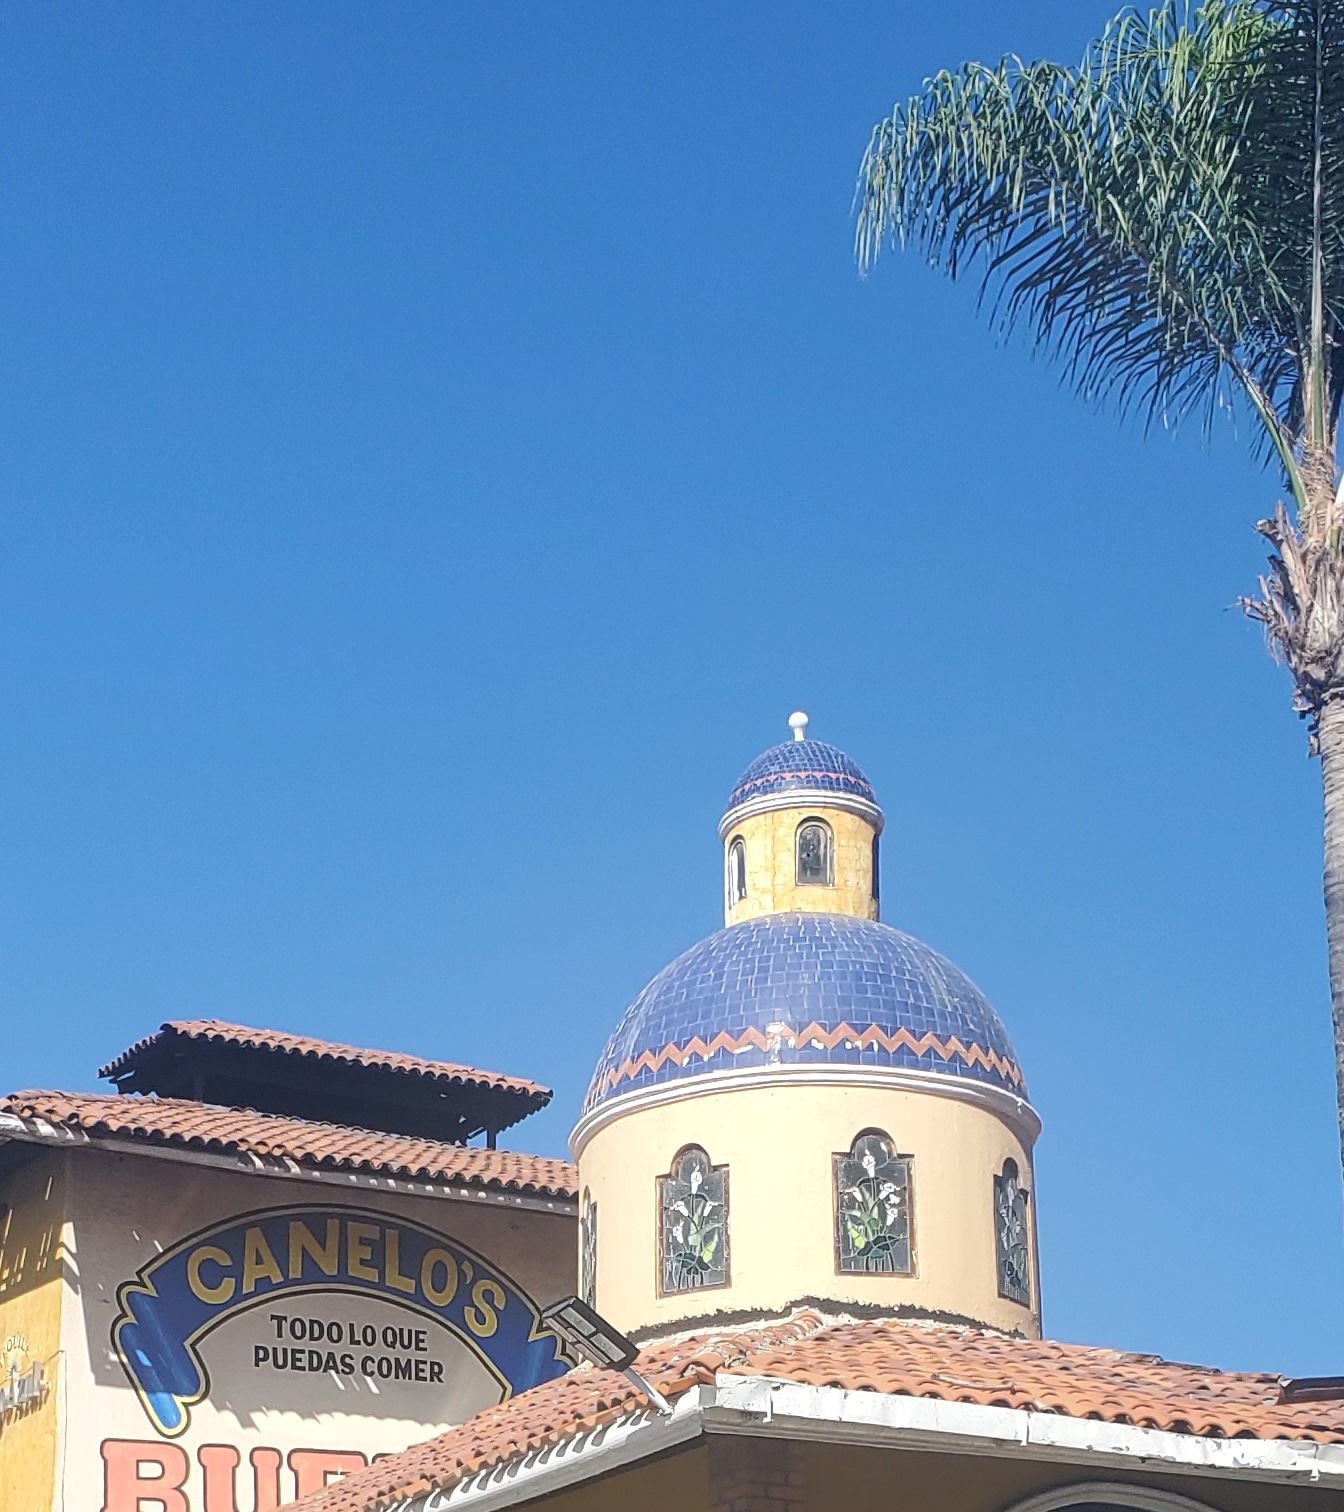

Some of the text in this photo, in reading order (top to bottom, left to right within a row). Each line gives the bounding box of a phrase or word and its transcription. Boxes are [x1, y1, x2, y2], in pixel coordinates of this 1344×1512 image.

[187, 1218, 506, 1338] CANELO'S
[270, 1314, 427, 1352] TODO LO QUE
[254, 1345, 444, 1383] PUEDAS COMER
